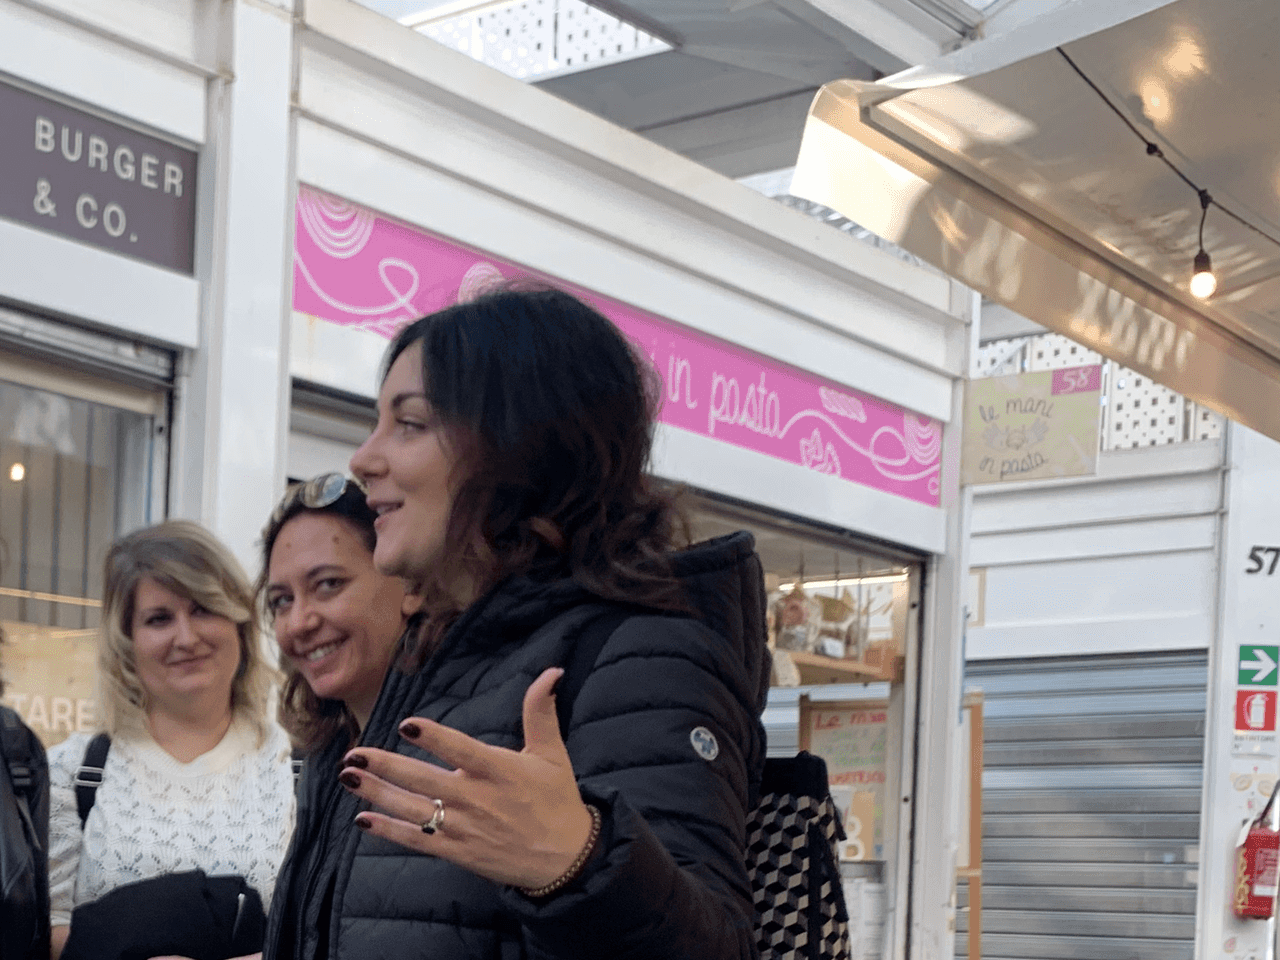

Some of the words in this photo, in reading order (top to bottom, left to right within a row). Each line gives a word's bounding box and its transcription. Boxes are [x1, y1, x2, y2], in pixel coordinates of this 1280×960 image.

[35, 115, 183, 197] BURGER
[33, 177, 57, 217] &
[75, 193, 138, 242] CO.
[667, 341, 698, 409] in
[708, 371, 782, 437] pasta
[1060, 368, 1092, 394] 58
[1006, 397, 1054, 418] mani
[1000, 451, 1049, 479] pasta
[1245, 545, 1280, 576] 57
